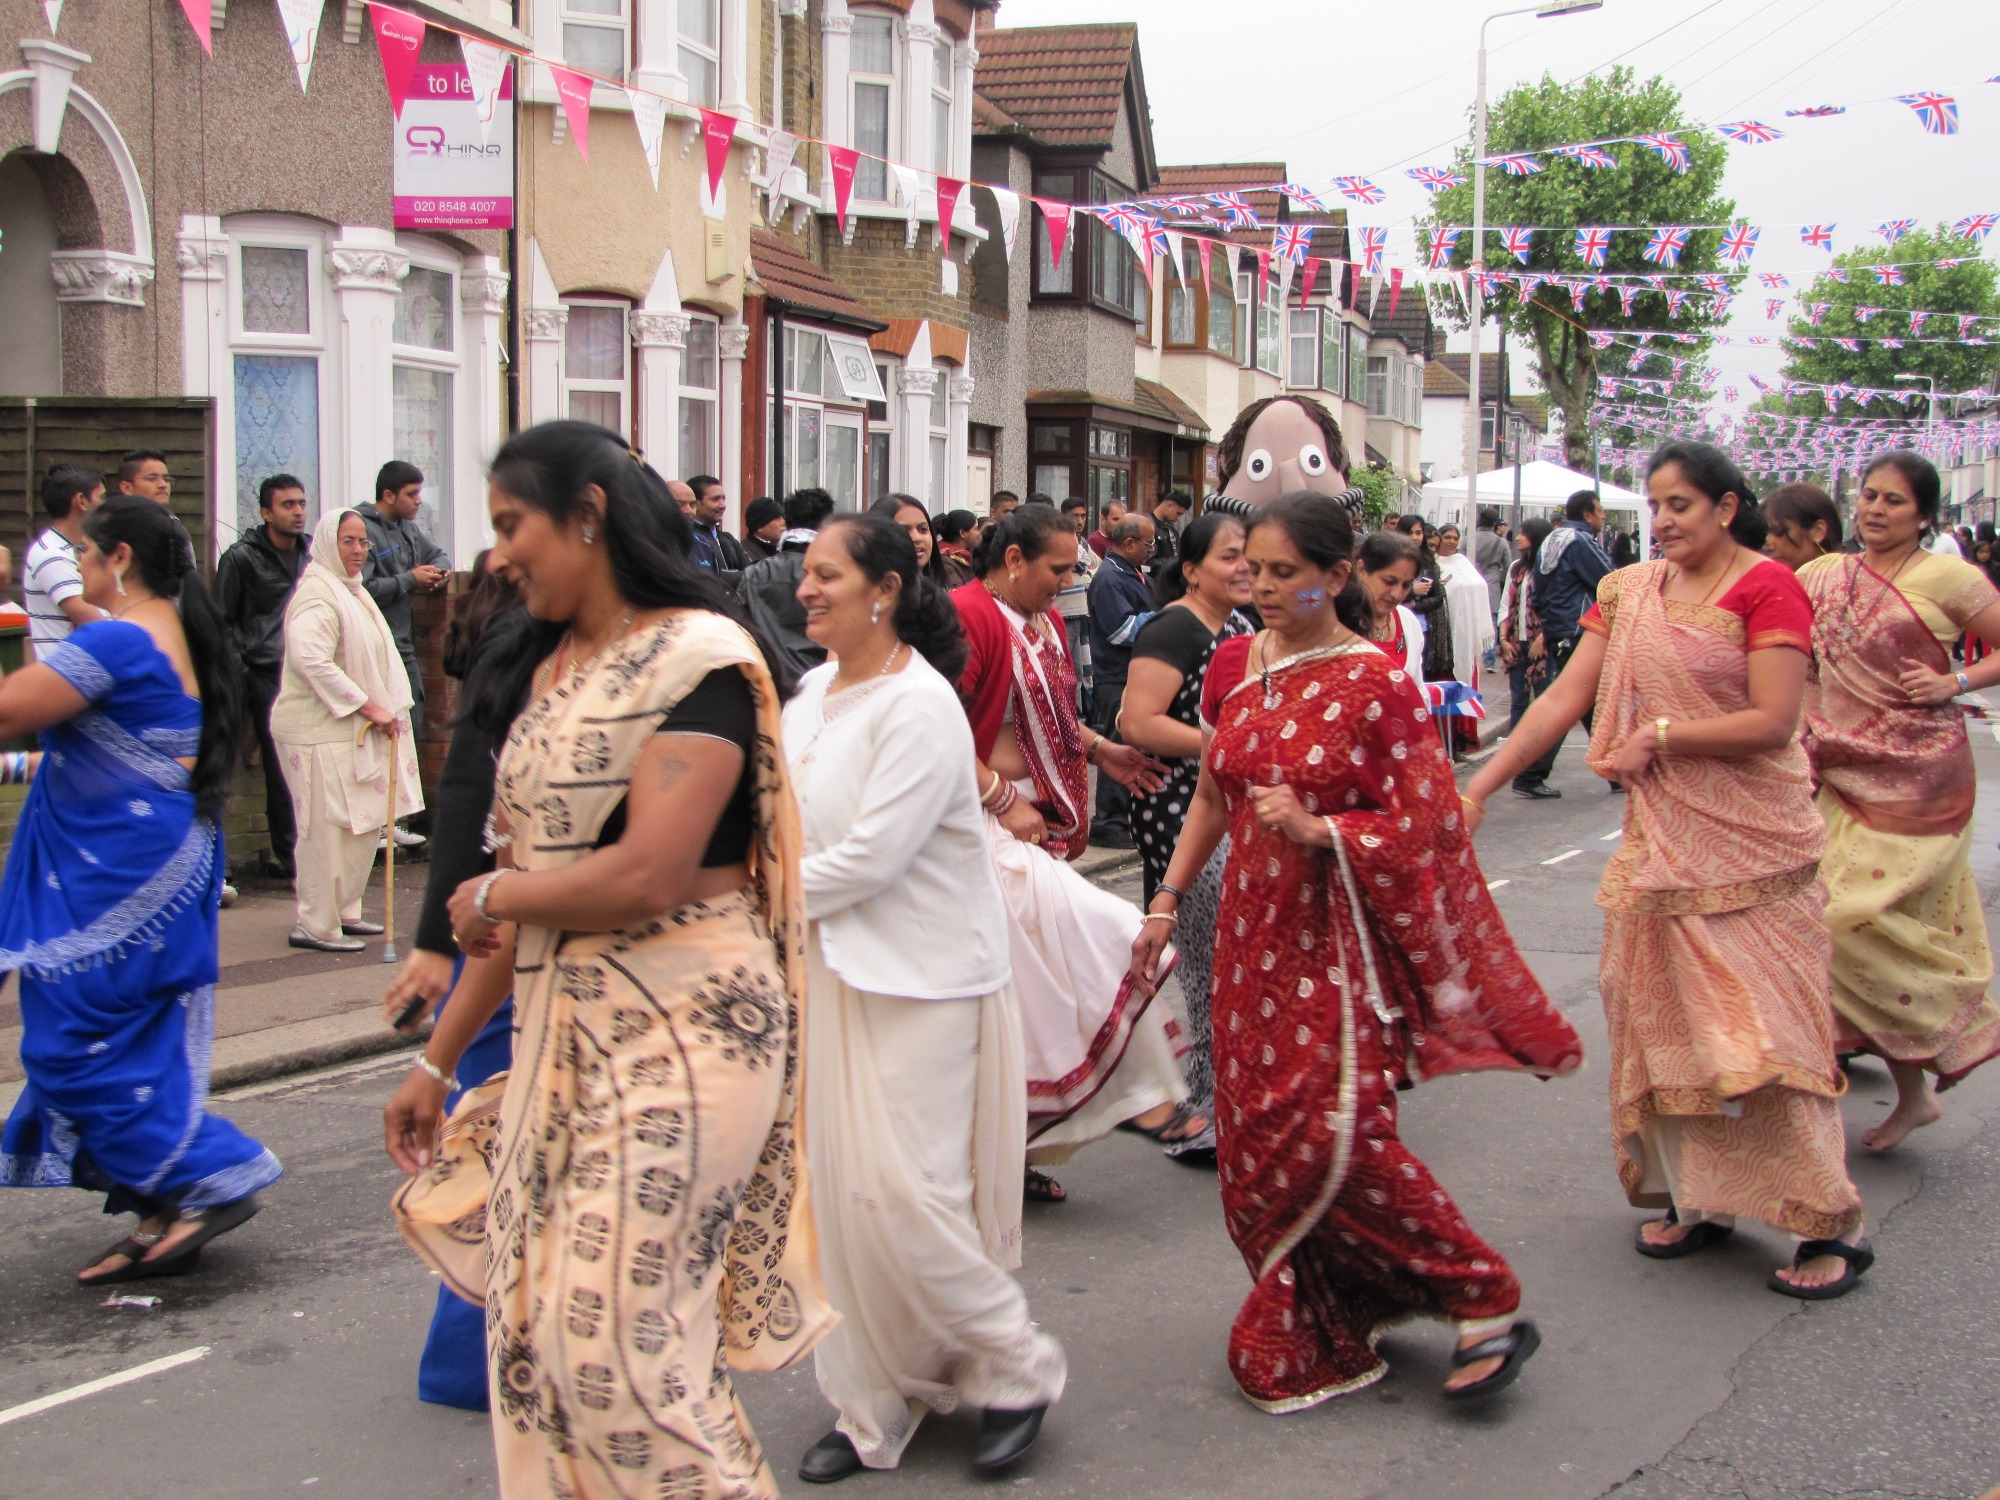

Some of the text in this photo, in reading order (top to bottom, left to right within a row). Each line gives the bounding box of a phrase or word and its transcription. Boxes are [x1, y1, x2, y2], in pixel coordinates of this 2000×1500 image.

[428, 72, 472, 93] to le
[414, 201, 497, 212] 020 8548 4007
[414, 216, 489, 226] www.thinqhomescom
